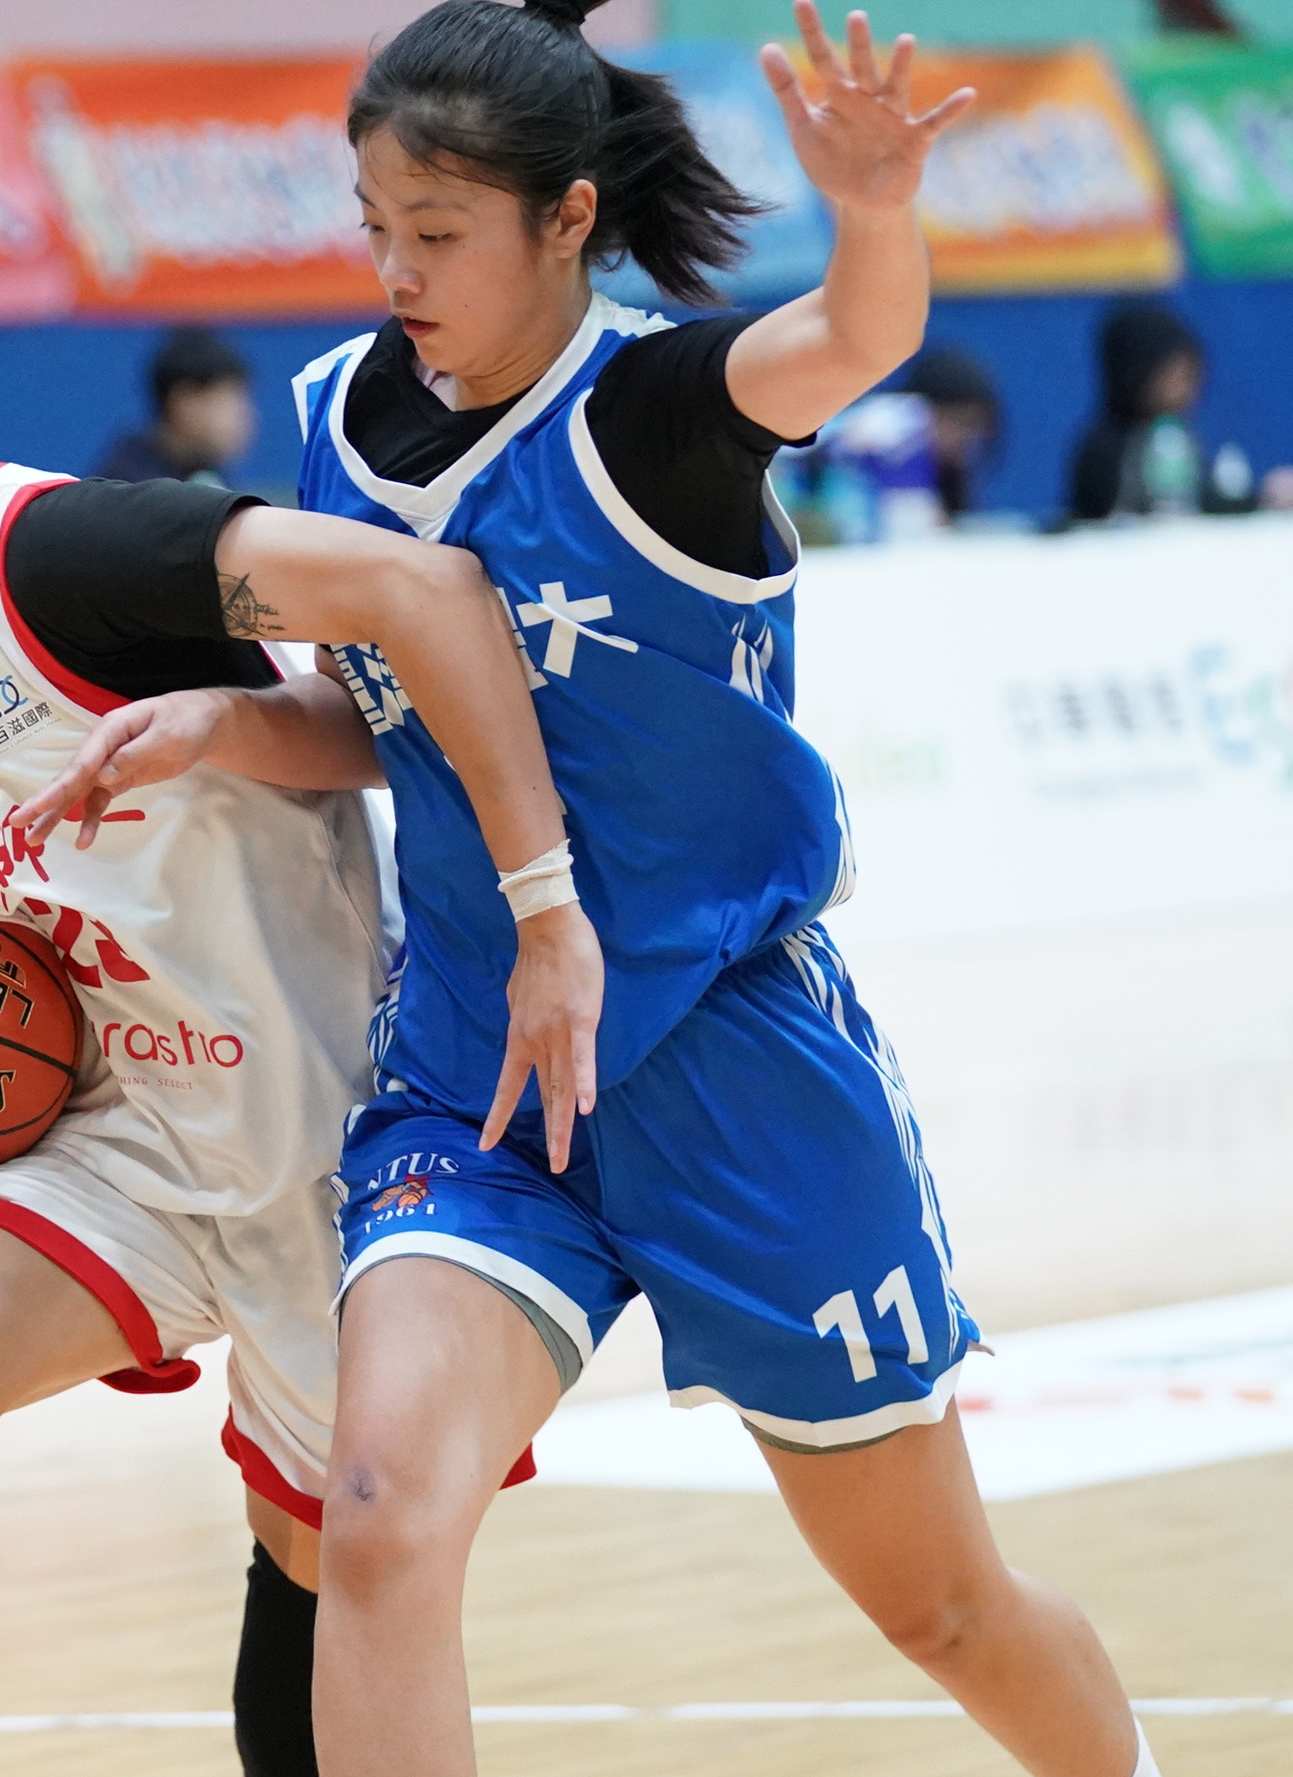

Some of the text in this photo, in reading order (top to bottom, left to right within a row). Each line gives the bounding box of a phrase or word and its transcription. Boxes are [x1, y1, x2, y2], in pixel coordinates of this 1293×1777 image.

[114, 1076, 194, 1090] HING SELECT
[367, 1152, 460, 1192] NTUS
[365, 1203, 436, 1234] 1961
[812, 1264, 930, 1384] 11
